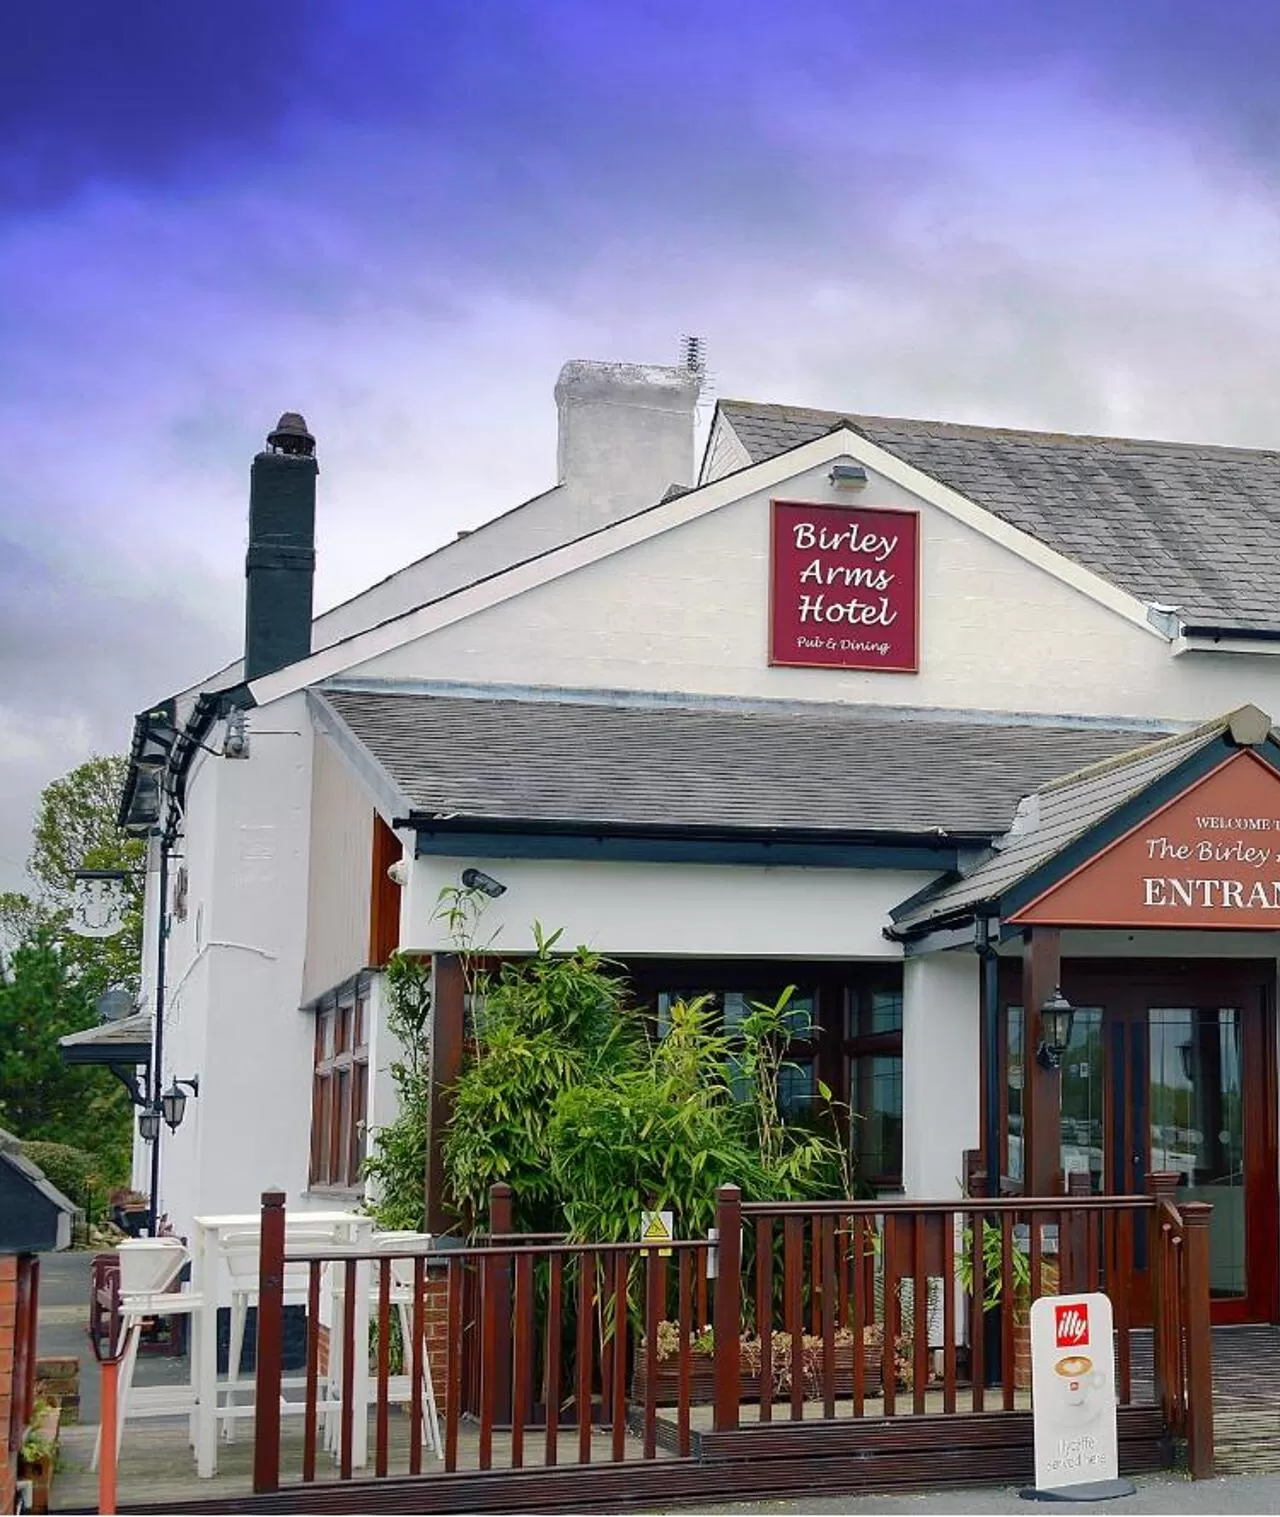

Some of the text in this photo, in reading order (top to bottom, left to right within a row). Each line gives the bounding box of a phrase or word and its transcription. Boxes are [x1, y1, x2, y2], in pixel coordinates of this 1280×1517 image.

[793, 522, 898, 562] Birley
[800, 559, 895, 591] Arms
[799, 594, 897, 626] Hotel
[797, 636, 890, 655] Pub & Dining
[1196, 816, 1270, 831] WELCOME
[1146, 838, 1193, 860] The
[1198, 840, 1270, 868] Birley
[1058, 1310, 1087, 1344] illy
